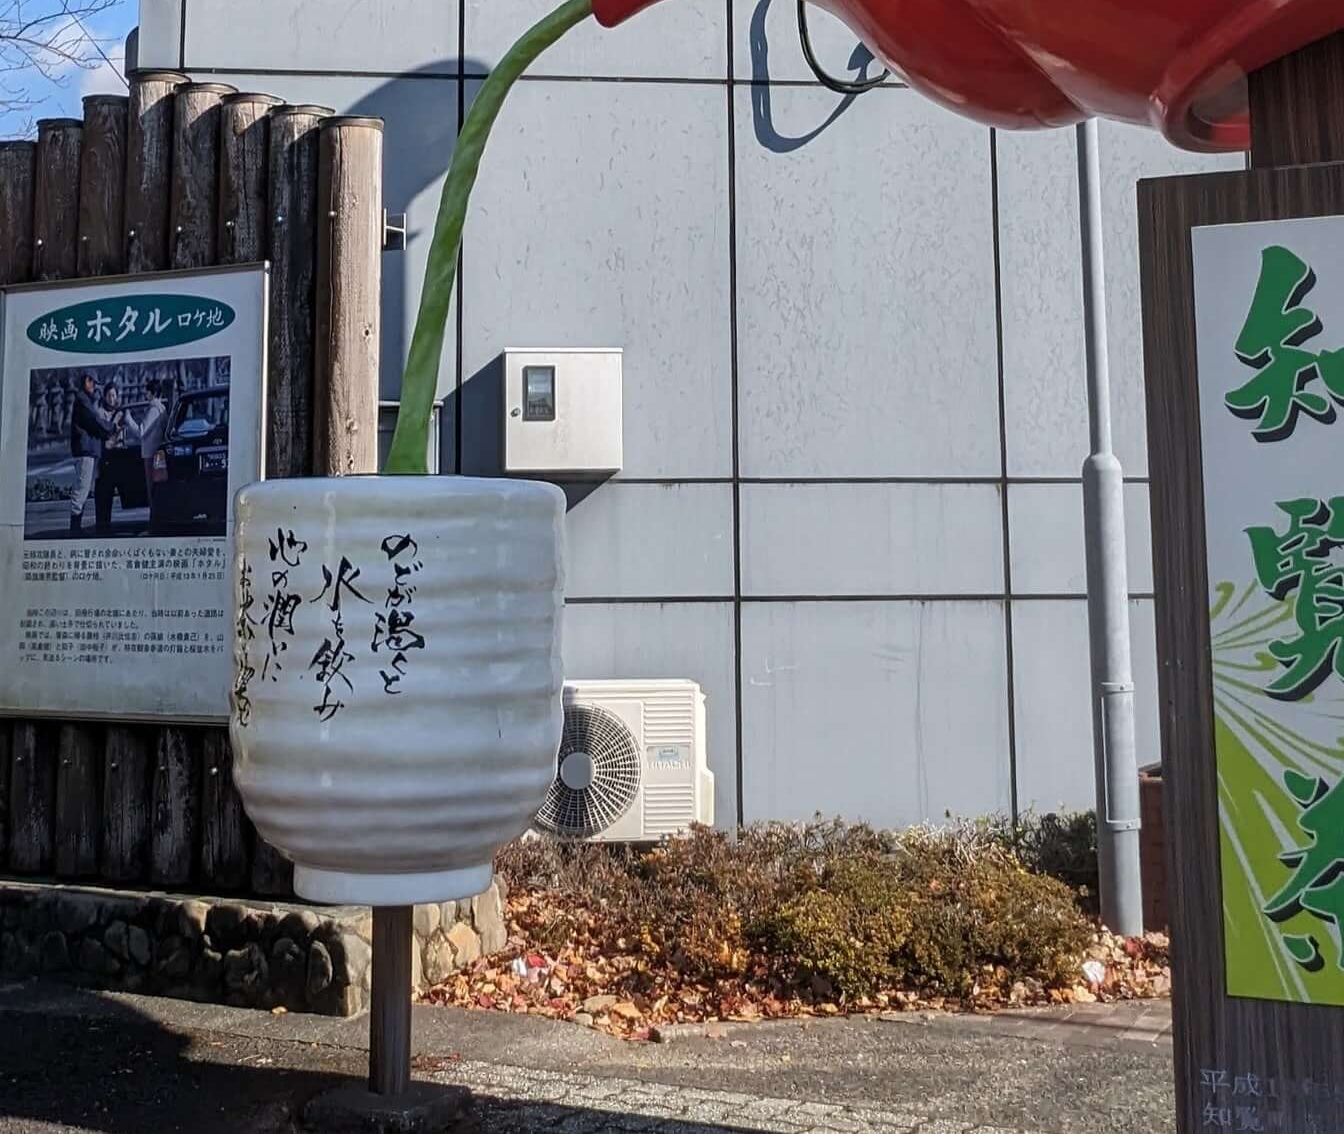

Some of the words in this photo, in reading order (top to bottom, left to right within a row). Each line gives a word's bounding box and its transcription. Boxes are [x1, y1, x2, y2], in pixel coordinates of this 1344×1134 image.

[38, 318, 79, 342] 映画
[86, 305, 172, 343] ホタル
[177, 306, 225, 328] ロケ地
